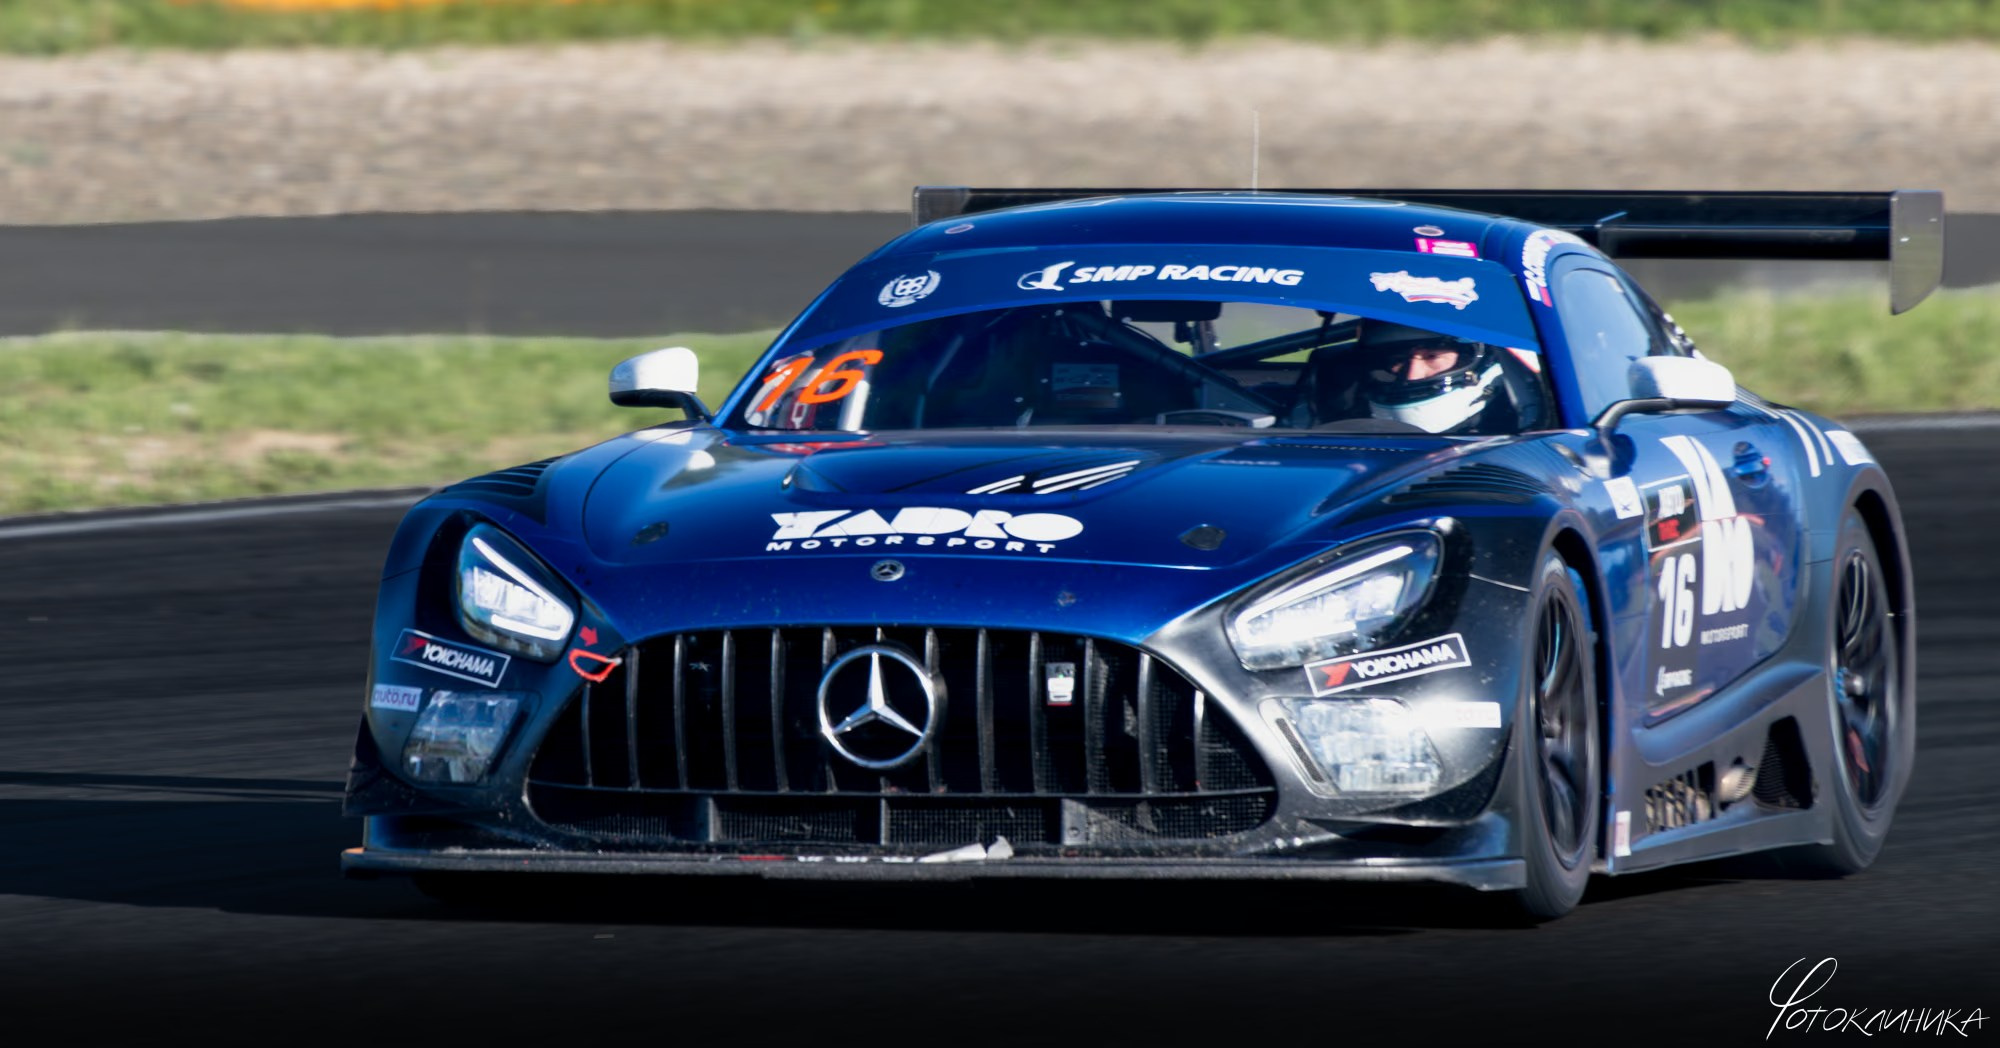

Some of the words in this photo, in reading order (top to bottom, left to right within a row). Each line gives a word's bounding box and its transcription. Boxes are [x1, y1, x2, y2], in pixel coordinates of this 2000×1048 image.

[1068, 265, 1156, 284] SMP
[1157, 264, 1305, 286] RACING
[756, 349, 884, 412] 16
[770, 506, 1084, 541] YADRO
[765, 535, 1056, 554] MOTORSPORT
[1657, 552, 1697, 649] 16
[421, 642, 495, 678] YOKOHAMA
[1350, 643, 1457, 679] YOKOHAMA
